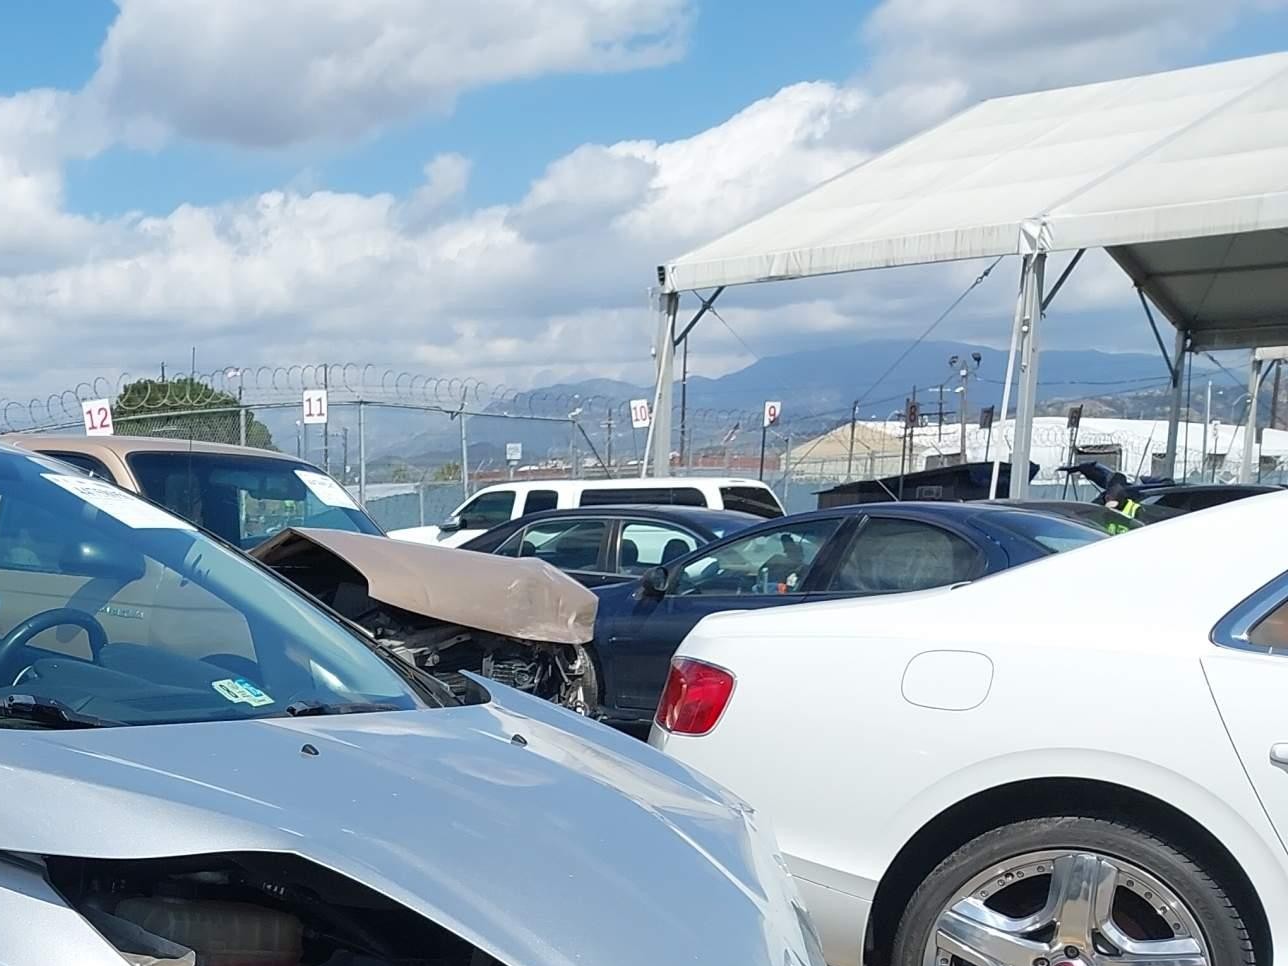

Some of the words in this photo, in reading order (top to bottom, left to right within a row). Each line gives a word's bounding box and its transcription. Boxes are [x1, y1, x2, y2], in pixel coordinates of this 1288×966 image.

[305, 397, 326, 417] 11
[633, 405, 649, 422] 10
[768, 405, 777, 422] 9
[908, 405, 917, 422] 8
[85, 406, 111, 431] 12
